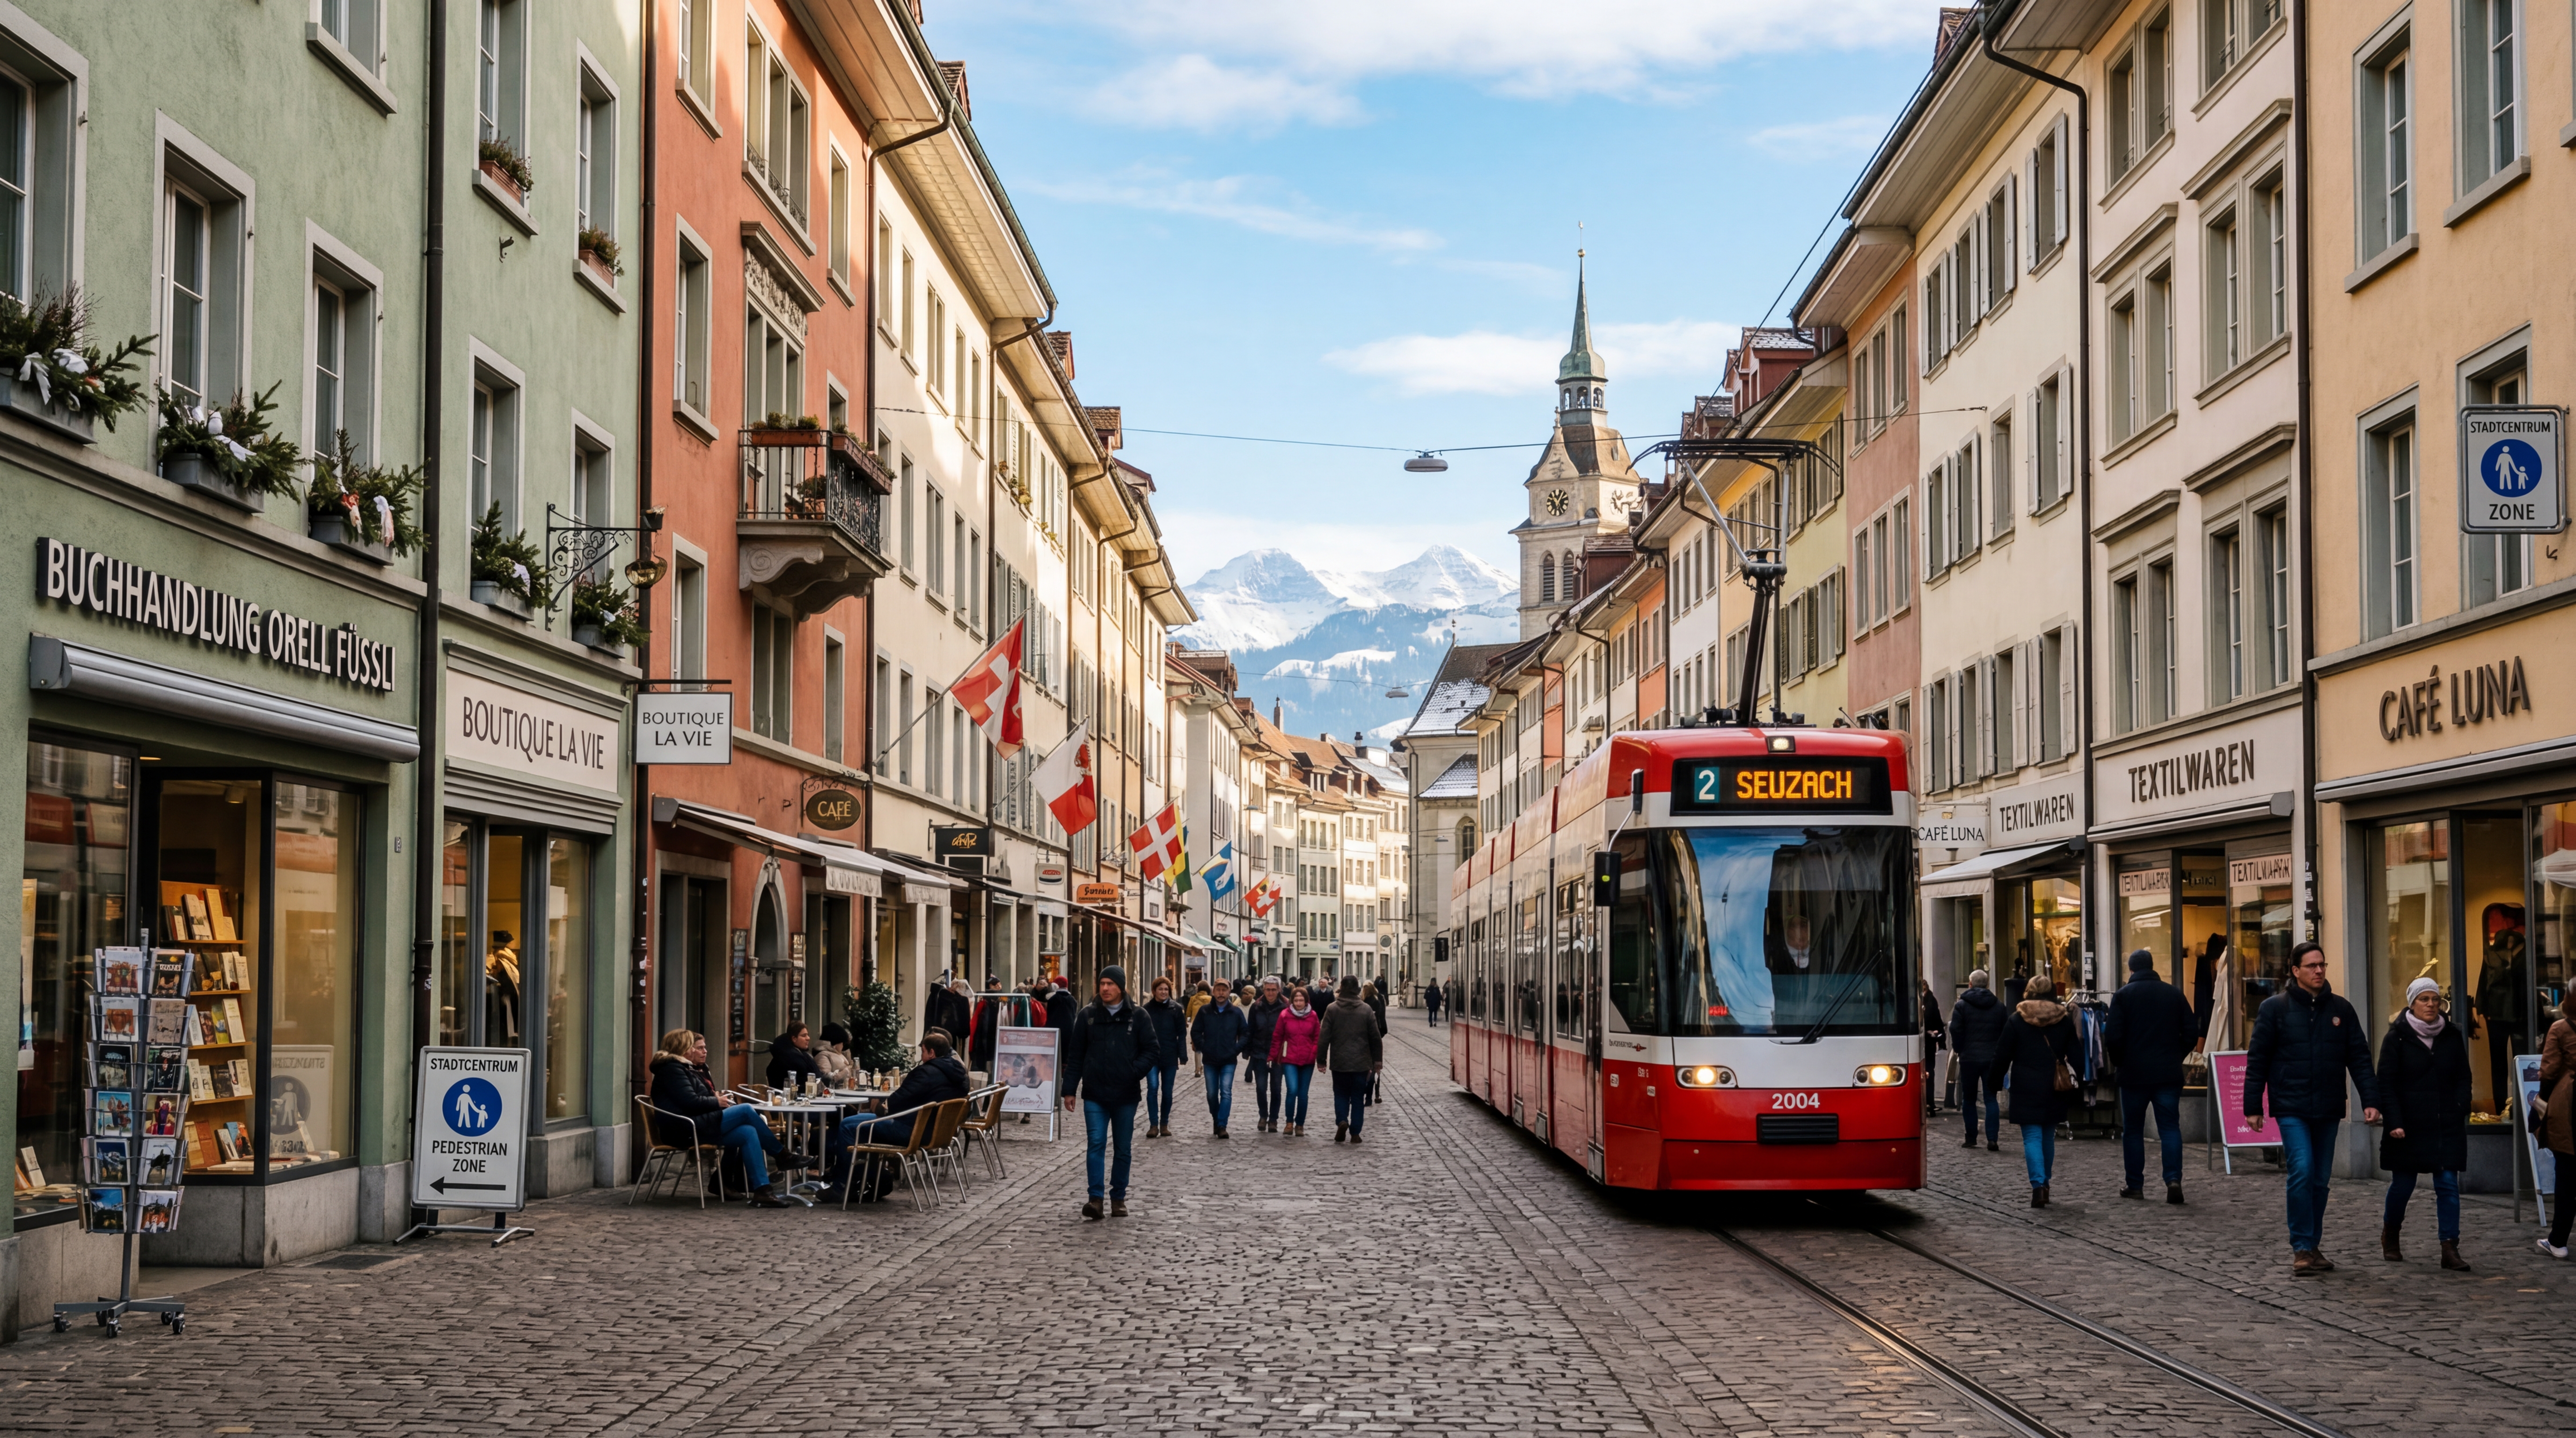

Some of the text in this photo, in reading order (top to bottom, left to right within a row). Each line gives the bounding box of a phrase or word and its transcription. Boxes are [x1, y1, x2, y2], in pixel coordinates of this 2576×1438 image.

[2470, 421, 2551, 433] STADTCENTRUM
[2489, 504, 2535, 521] ZONE
[47, 537, 395, 692] BUCHHANDLUNG ORELL FÜSSLI
[2379, 655, 2531, 741] CAFÉ LUNA
[643, 712, 724, 728] BOUTIQUE
[463, 697, 604, 770] BOUTIQUE LA VIE
[655, 731, 712, 746] LA VIE
[2128, 739, 2254, 803] TEXTILWAREN
[1698, 770, 1852, 800] 2 SEUZACH
[1999, 793, 2074, 833] TEXTILWAREN
[1951, 827, 1985, 841] LUNA
[431, 1058, 518, 1072] STADTCENTRUM
[1771, 1093, 1820, 1110] 2004
[432, 1140, 508, 1156] PEDESTRIAN
[452, 1159, 486, 1173] ZONE
